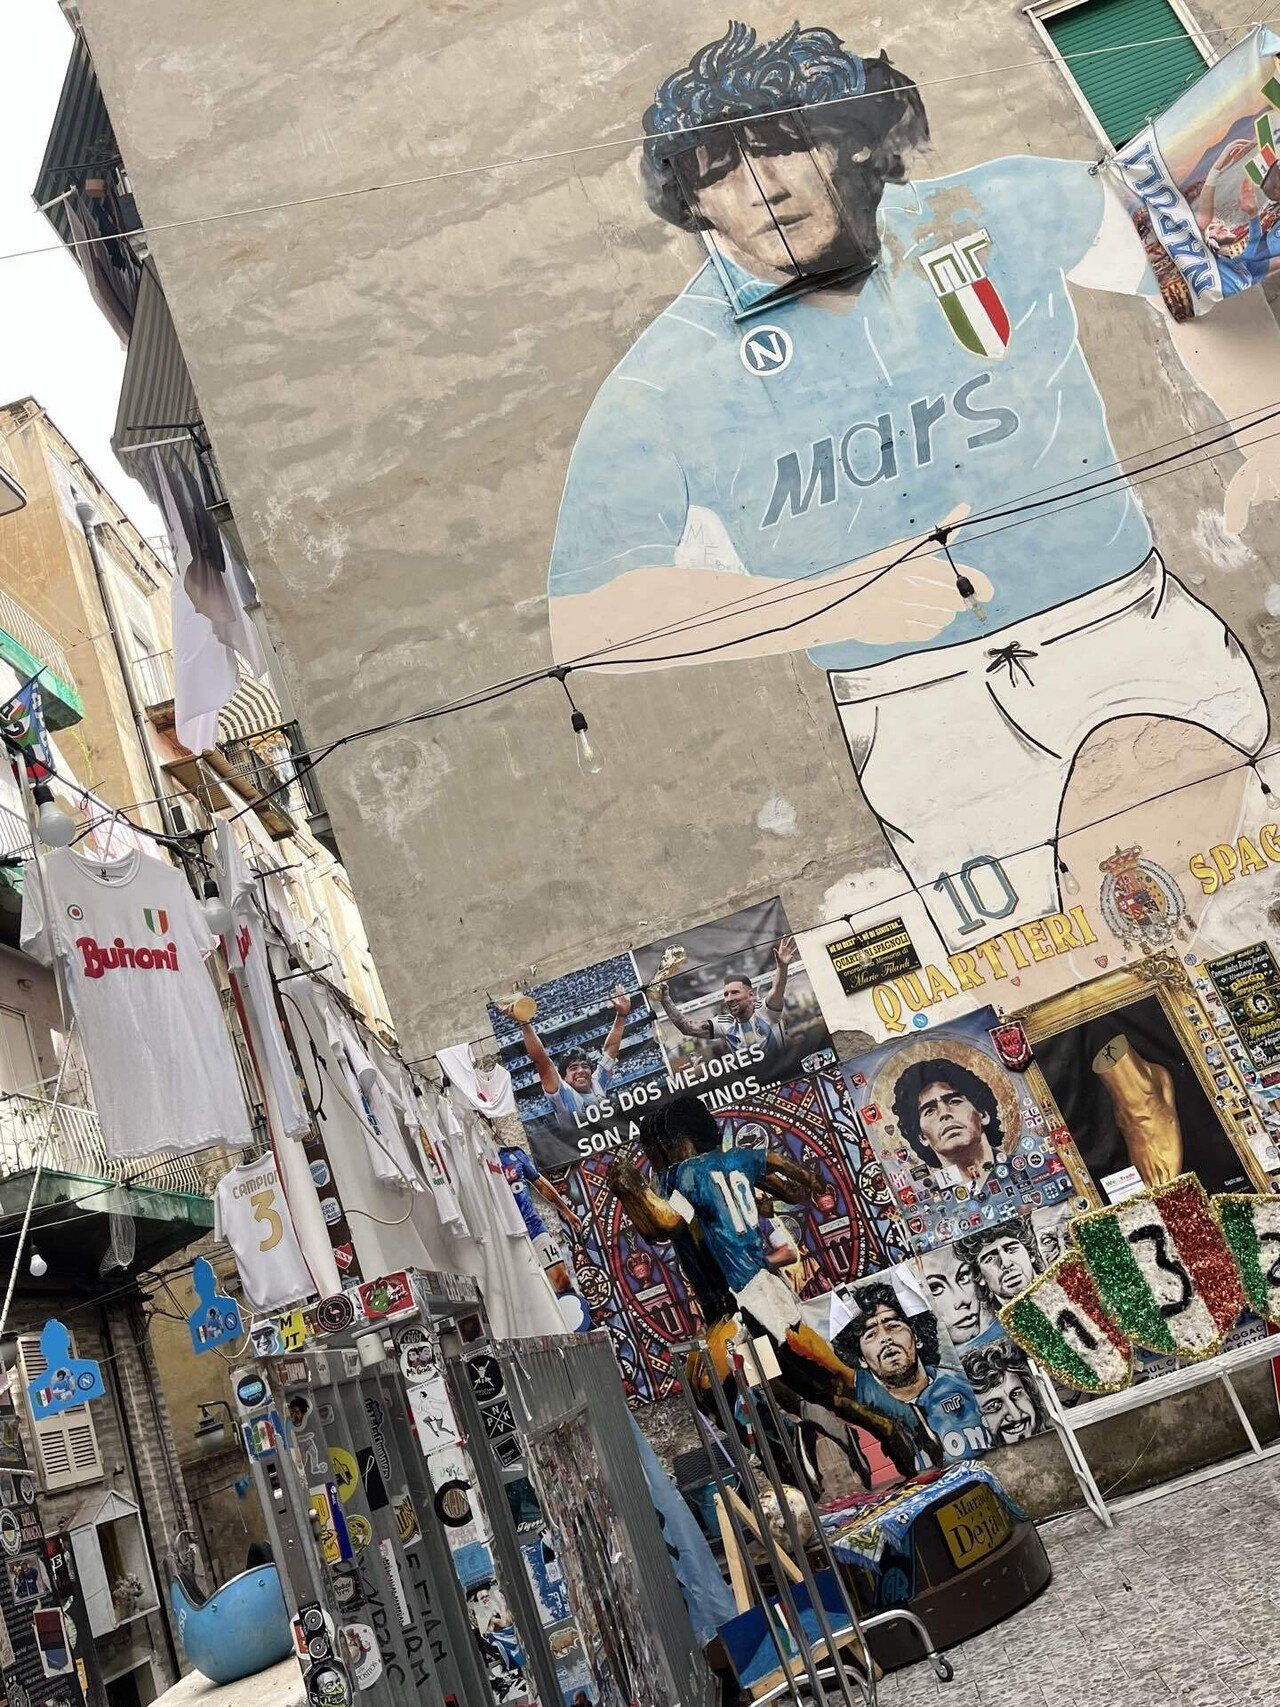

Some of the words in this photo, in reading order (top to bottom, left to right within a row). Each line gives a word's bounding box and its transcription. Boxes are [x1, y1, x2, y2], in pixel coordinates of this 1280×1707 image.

[746, 331, 786, 371] N
[933, 854, 1019, 935] 10
[835, 948, 874, 970] QUARTRI
[874, 934, 908, 956] SPAGNOLI
[872, 905, 1097, 1033] QUARTIERI
[1230, 972, 1265, 991] DIEGO
[573, 1099, 615, 1129] LOS
[618, 1081, 663, 1112] DOS
[665, 1044, 765, 1094] MEJORES
[577, 1126, 622, 1157] SON
[250, 1189, 283, 1252] 3
[711, 1169, 759, 1235] 10
[542, 1244, 561, 1262] 14
[1128, 1224, 1192, 1319] 3
[1056, 1308, 1099, 1351] 1
